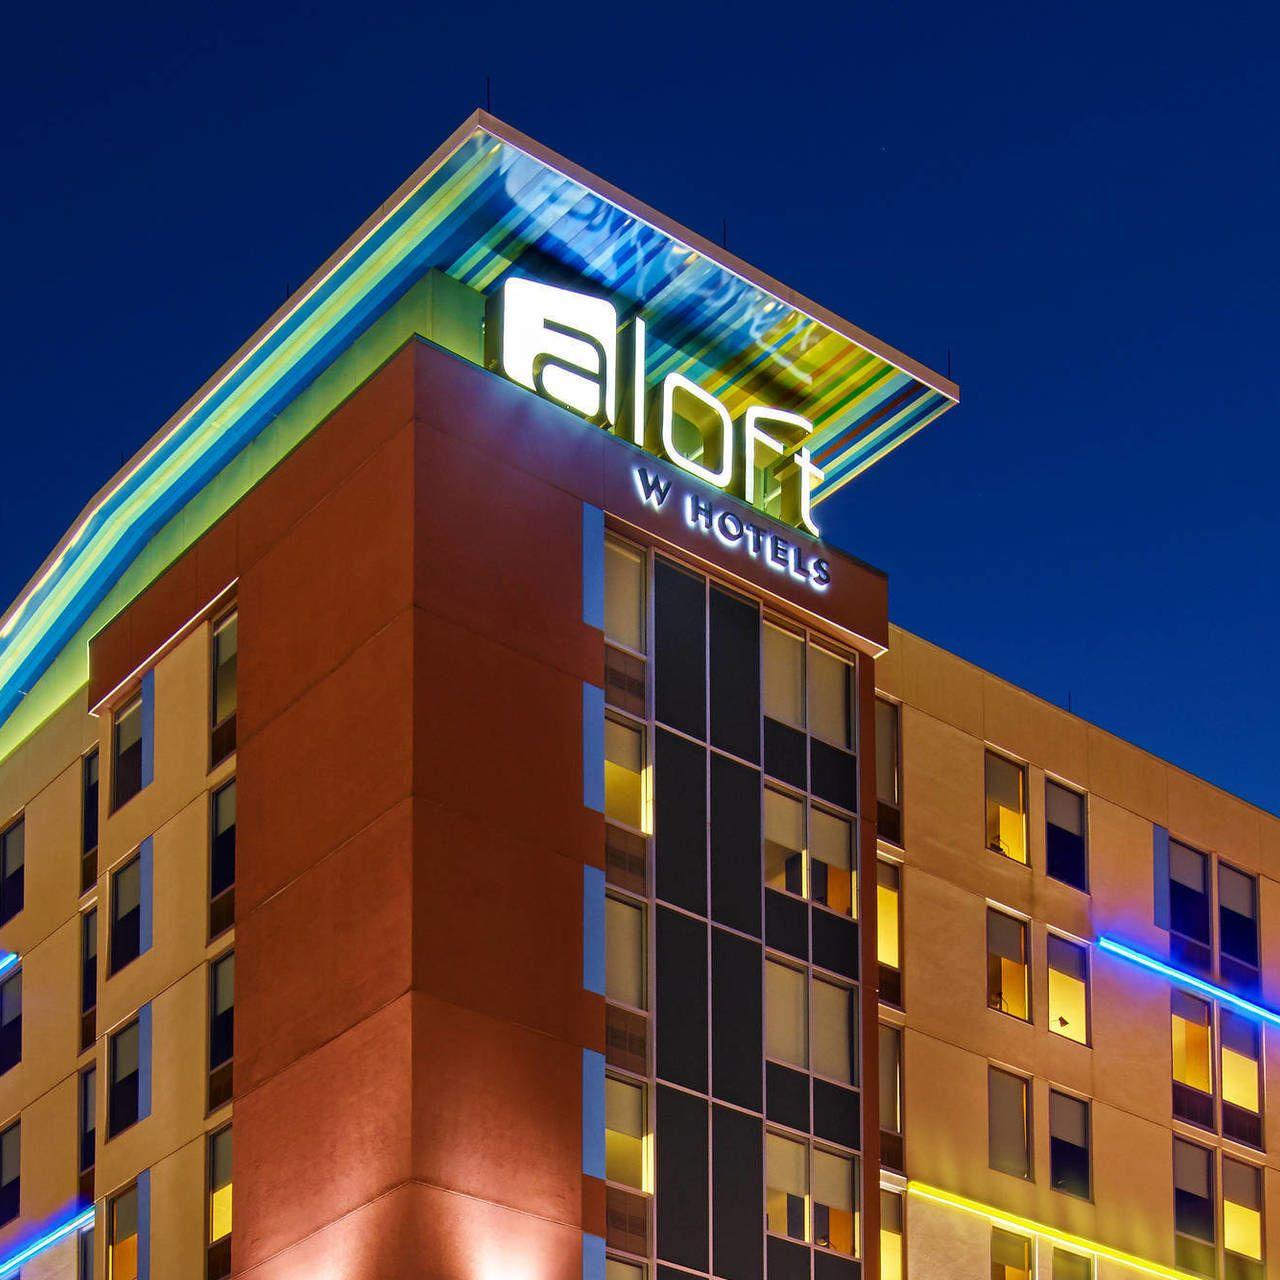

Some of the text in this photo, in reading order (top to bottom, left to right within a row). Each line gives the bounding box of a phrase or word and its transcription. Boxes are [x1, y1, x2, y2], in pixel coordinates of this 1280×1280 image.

[503, 276, 825, 537] aloft
[636, 467, 830, 590] W HOTELS
